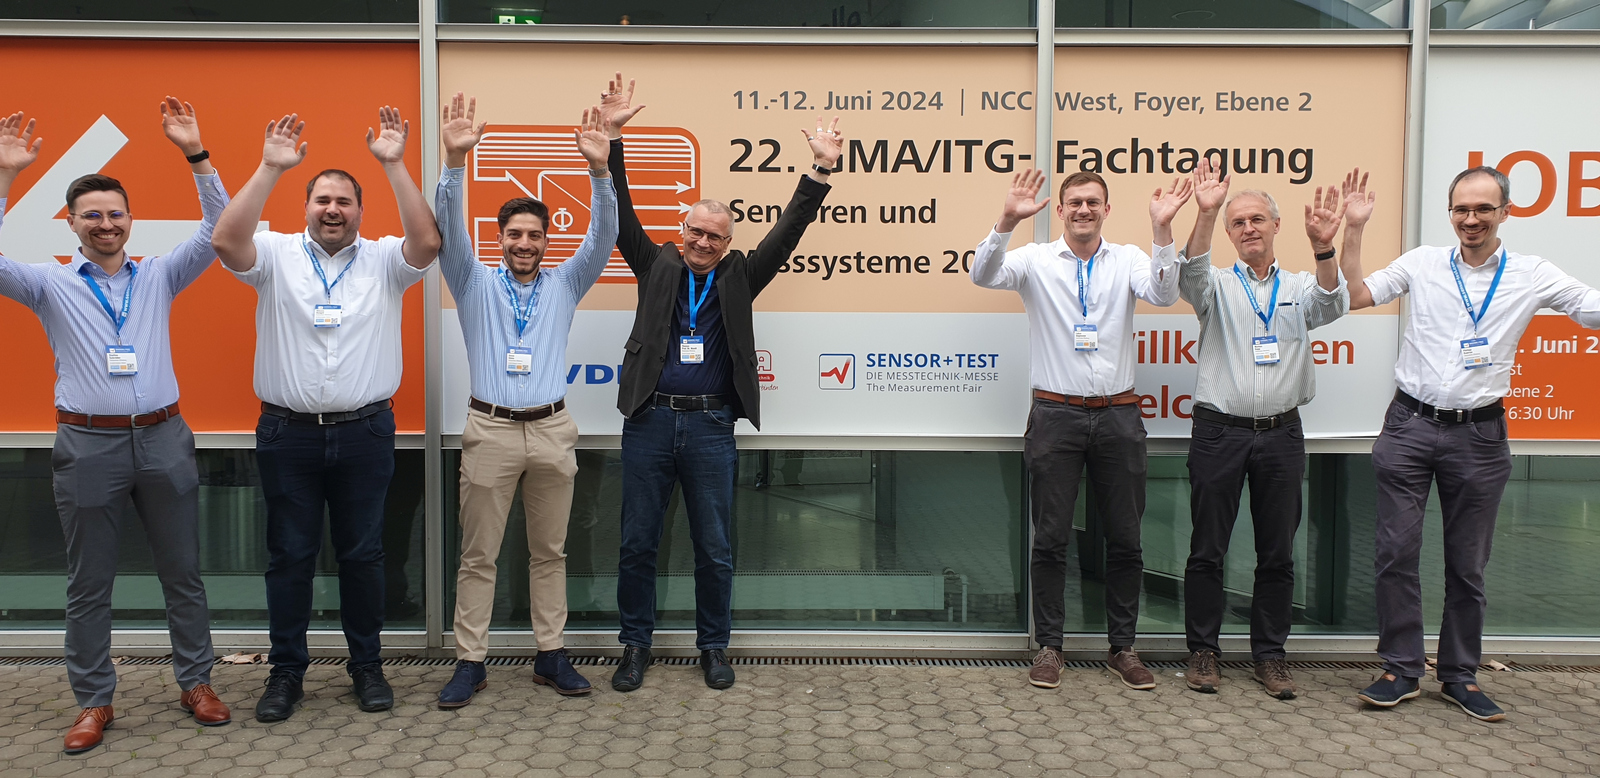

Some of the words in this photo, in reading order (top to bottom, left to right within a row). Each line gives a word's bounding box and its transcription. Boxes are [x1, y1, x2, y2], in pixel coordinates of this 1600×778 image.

[732, 90, 815, 111] 11.-12.
[824, 90, 873, 111] Juni
[881, 90, 944, 111] 2024
[980, 90, 1033, 111] NCC
[1054, 91, 1124, 115] West,
[1134, 91, 1206, 117] Foyer,
[1215, 90, 1290, 112] Ebene
[1298, 91, 1313, 112] 2
[729, 138, 796, 173] 22.
[1055, 137, 1314, 185] Fachtagung
[729, 198, 867, 224] Senren
[879, 198, 937, 224] und
[1532, 335, 1578, 354] Juni
[866, 353, 999, 368] SENSOR+TEST
[866, 371, 883, 381] DIE
[886, 371, 999, 382] MESSTECHNIK-MESSE
[866, 383, 886, 392] The
[888, 383, 960, 393] Measurement
[962, 383, 983, 393] Fair
[1544, 384, 1555, 398] 2
[1547, 405, 1575, 420] Uhr
